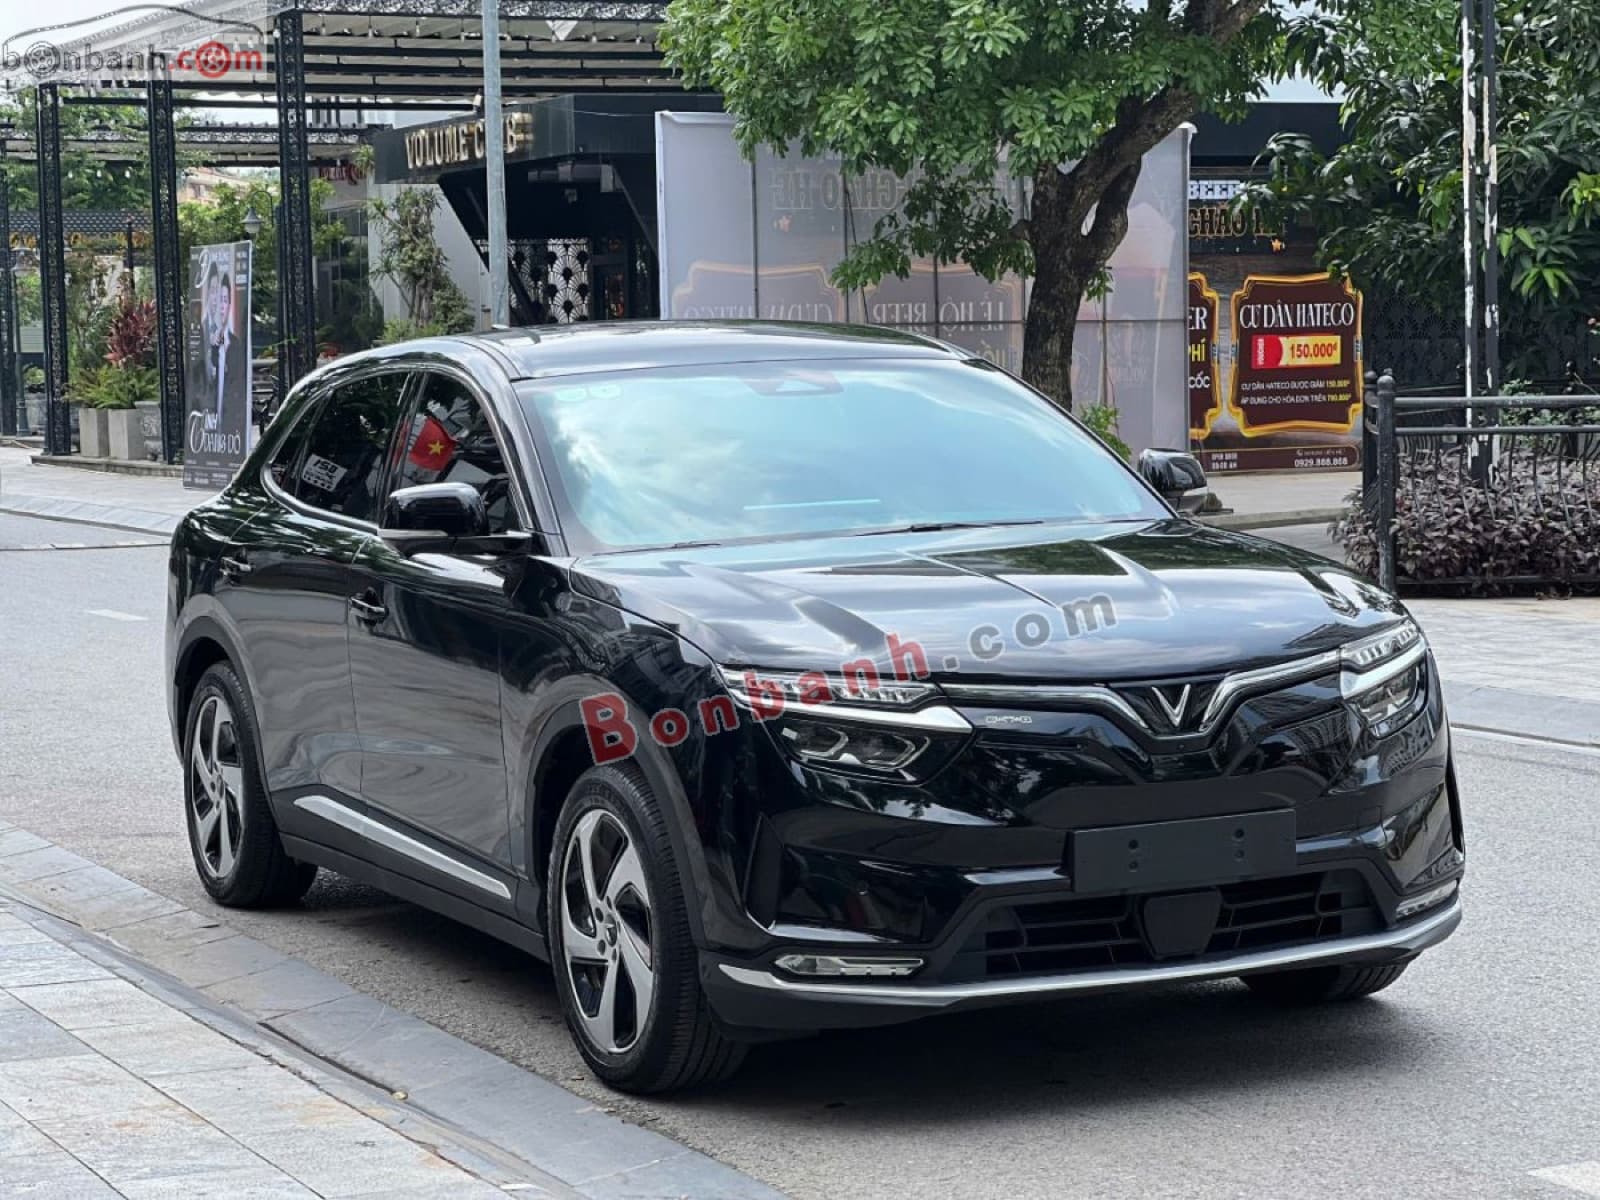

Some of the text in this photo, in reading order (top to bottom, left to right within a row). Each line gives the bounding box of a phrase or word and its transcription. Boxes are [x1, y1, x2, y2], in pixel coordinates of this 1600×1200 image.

[405, 113, 517, 169] VOLUME CB
[1296, 302, 1354, 328] HATECO
